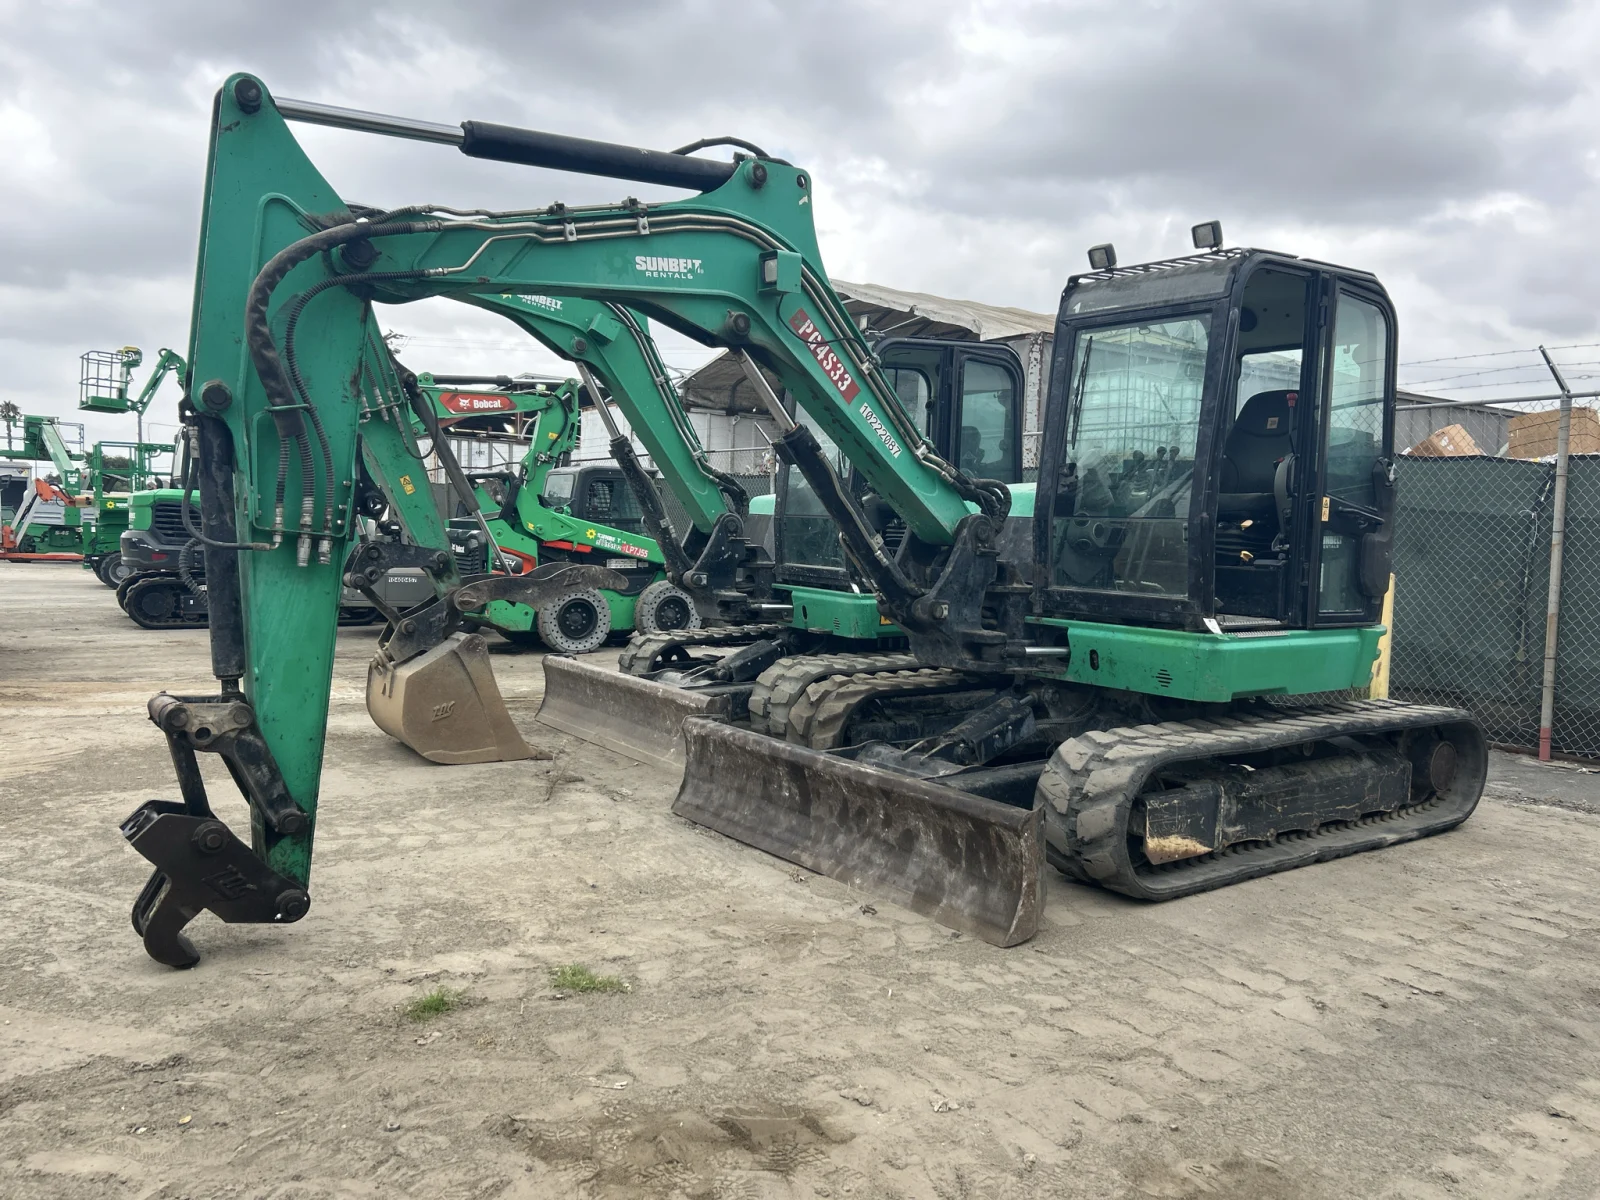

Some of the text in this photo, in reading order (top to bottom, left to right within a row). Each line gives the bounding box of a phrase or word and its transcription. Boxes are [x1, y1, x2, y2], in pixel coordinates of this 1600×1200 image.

[516, 294, 563, 310] UNBELT
[473, 399, 502, 409] Bobcat
[861, 405, 902, 455] 10222087
